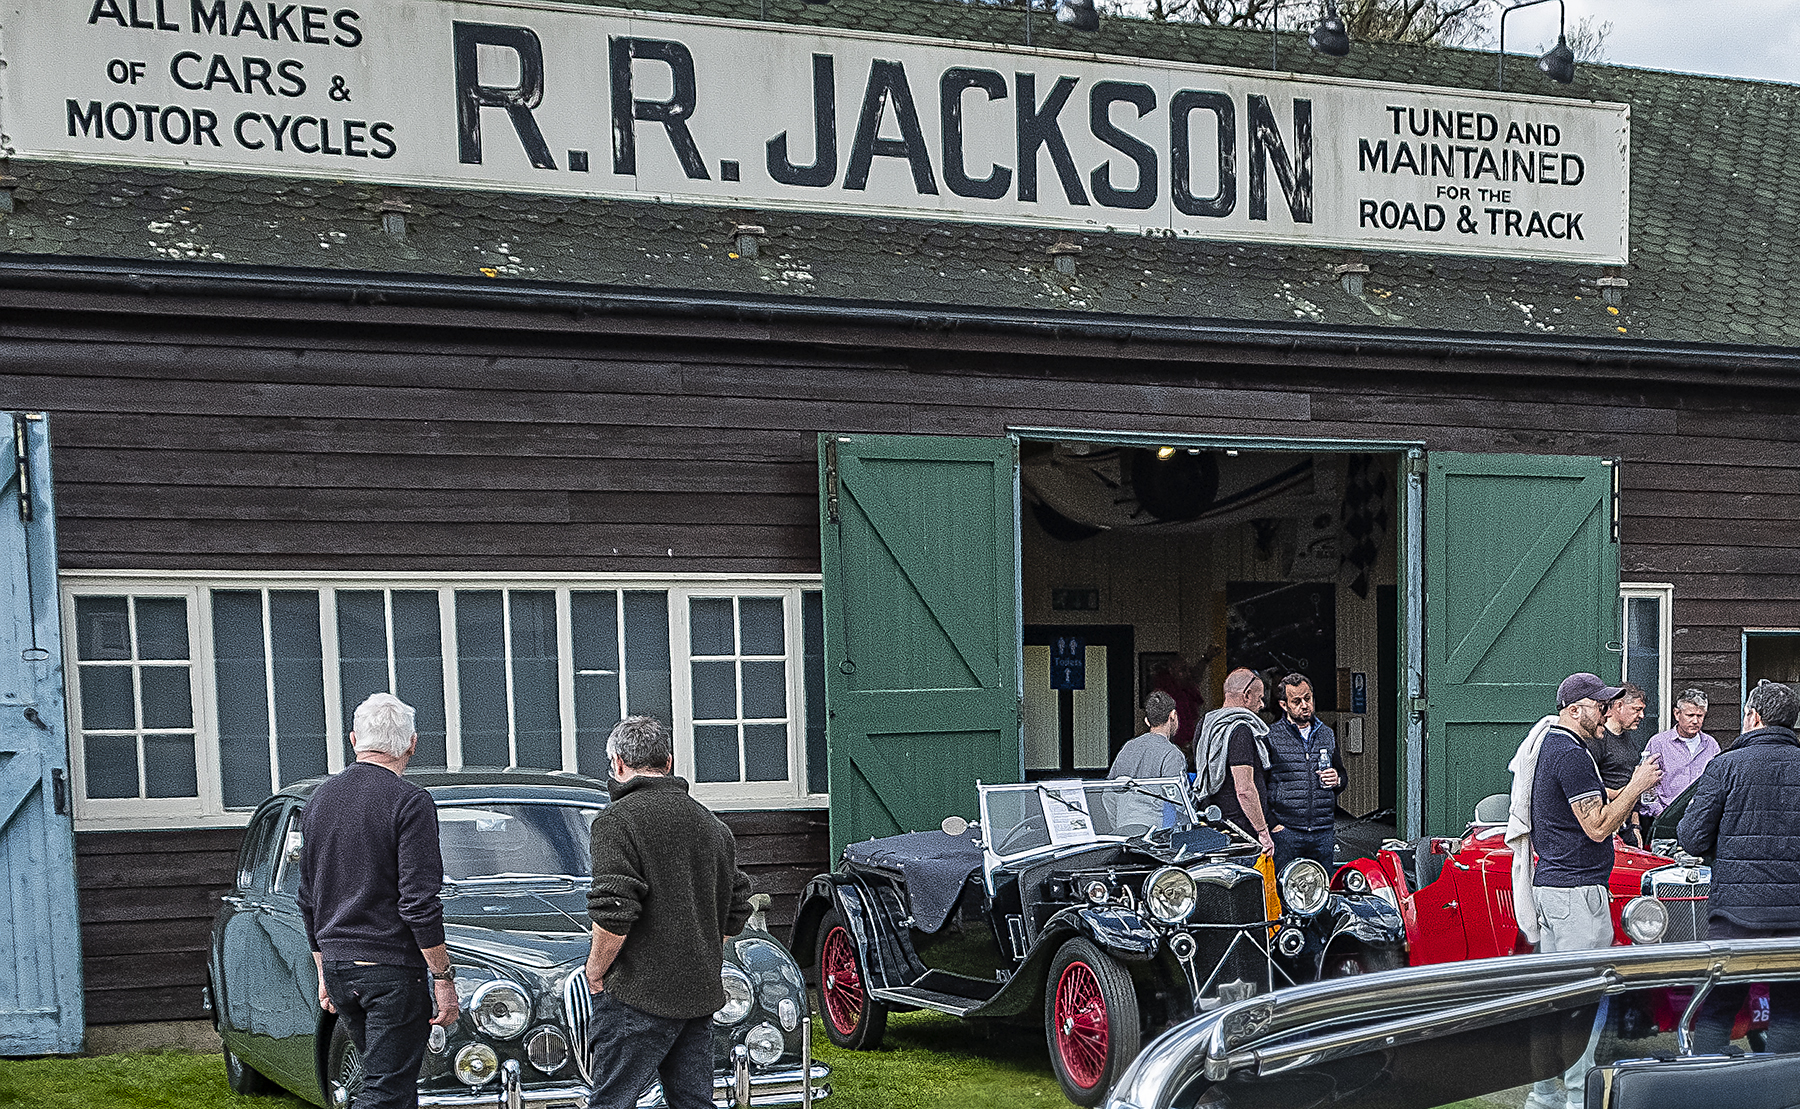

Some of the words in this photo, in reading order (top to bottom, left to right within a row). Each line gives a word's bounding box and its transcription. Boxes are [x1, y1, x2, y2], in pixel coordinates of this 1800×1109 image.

[88, 0, 180, 31] ALL
[190, 0, 363, 48] MAKES
[107, 59, 146, 85] OF
[170, 51, 307, 98] CARS
[328, 75, 351, 102] &
[66, 99, 221, 147] MOTOR
[234, 112, 397, 160] CYCLES
[766, 53, 1313, 224] JACKSON
[1386, 105, 1499, 142] TUNED
[1505, 121, 1561, 147] AND
[1358, 138, 1585, 186] MAINTAINED
[1436, 186, 1471, 200] FOR
[1478, 188, 1511, 203] THE
[1359, 199, 1446, 232] ROAD
[1456, 205, 1478, 235] &
[1484, 208, 1584, 241] TRACK
[1752, 1009, 1770, 1022] 26
